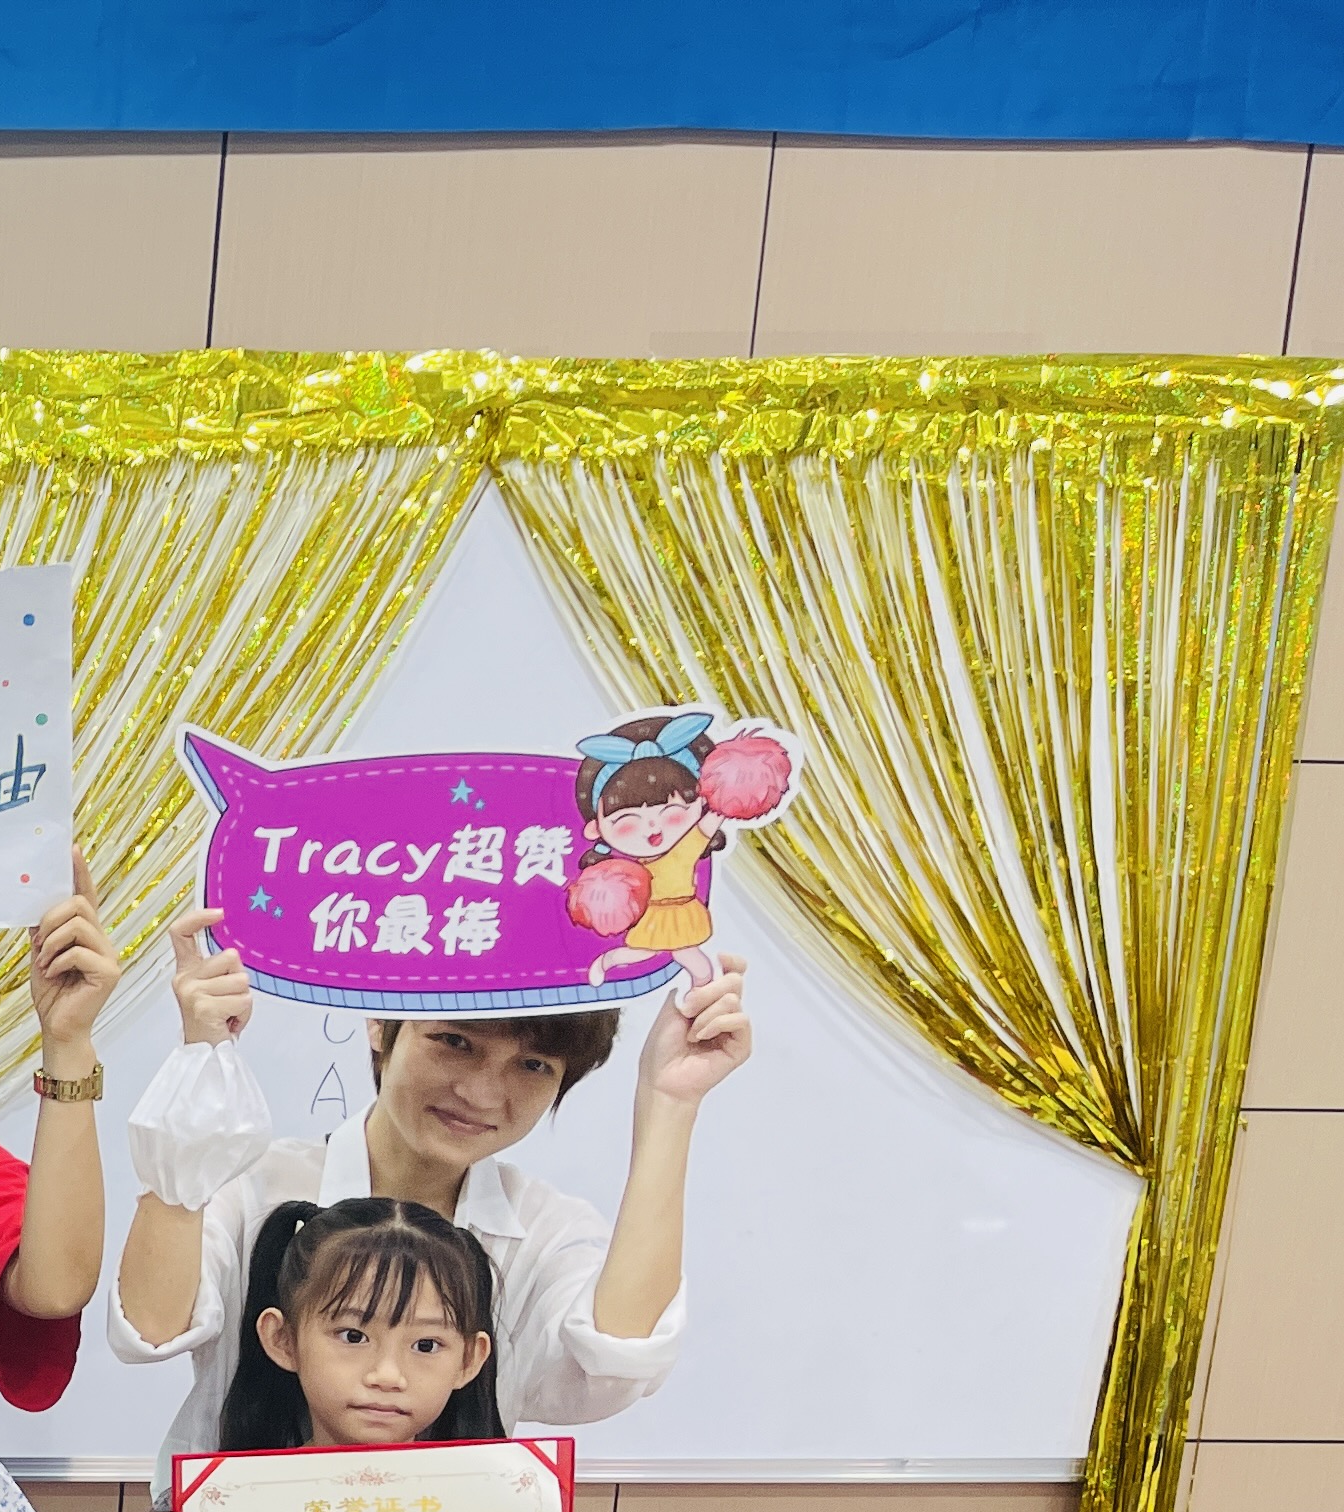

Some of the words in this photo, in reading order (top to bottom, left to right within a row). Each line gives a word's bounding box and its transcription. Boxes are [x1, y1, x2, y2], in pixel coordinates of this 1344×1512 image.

[253, 823, 574, 888] Tracy超赞
[310, 892, 503, 957] 你最棒
[311, 1061, 348, 1120] A
